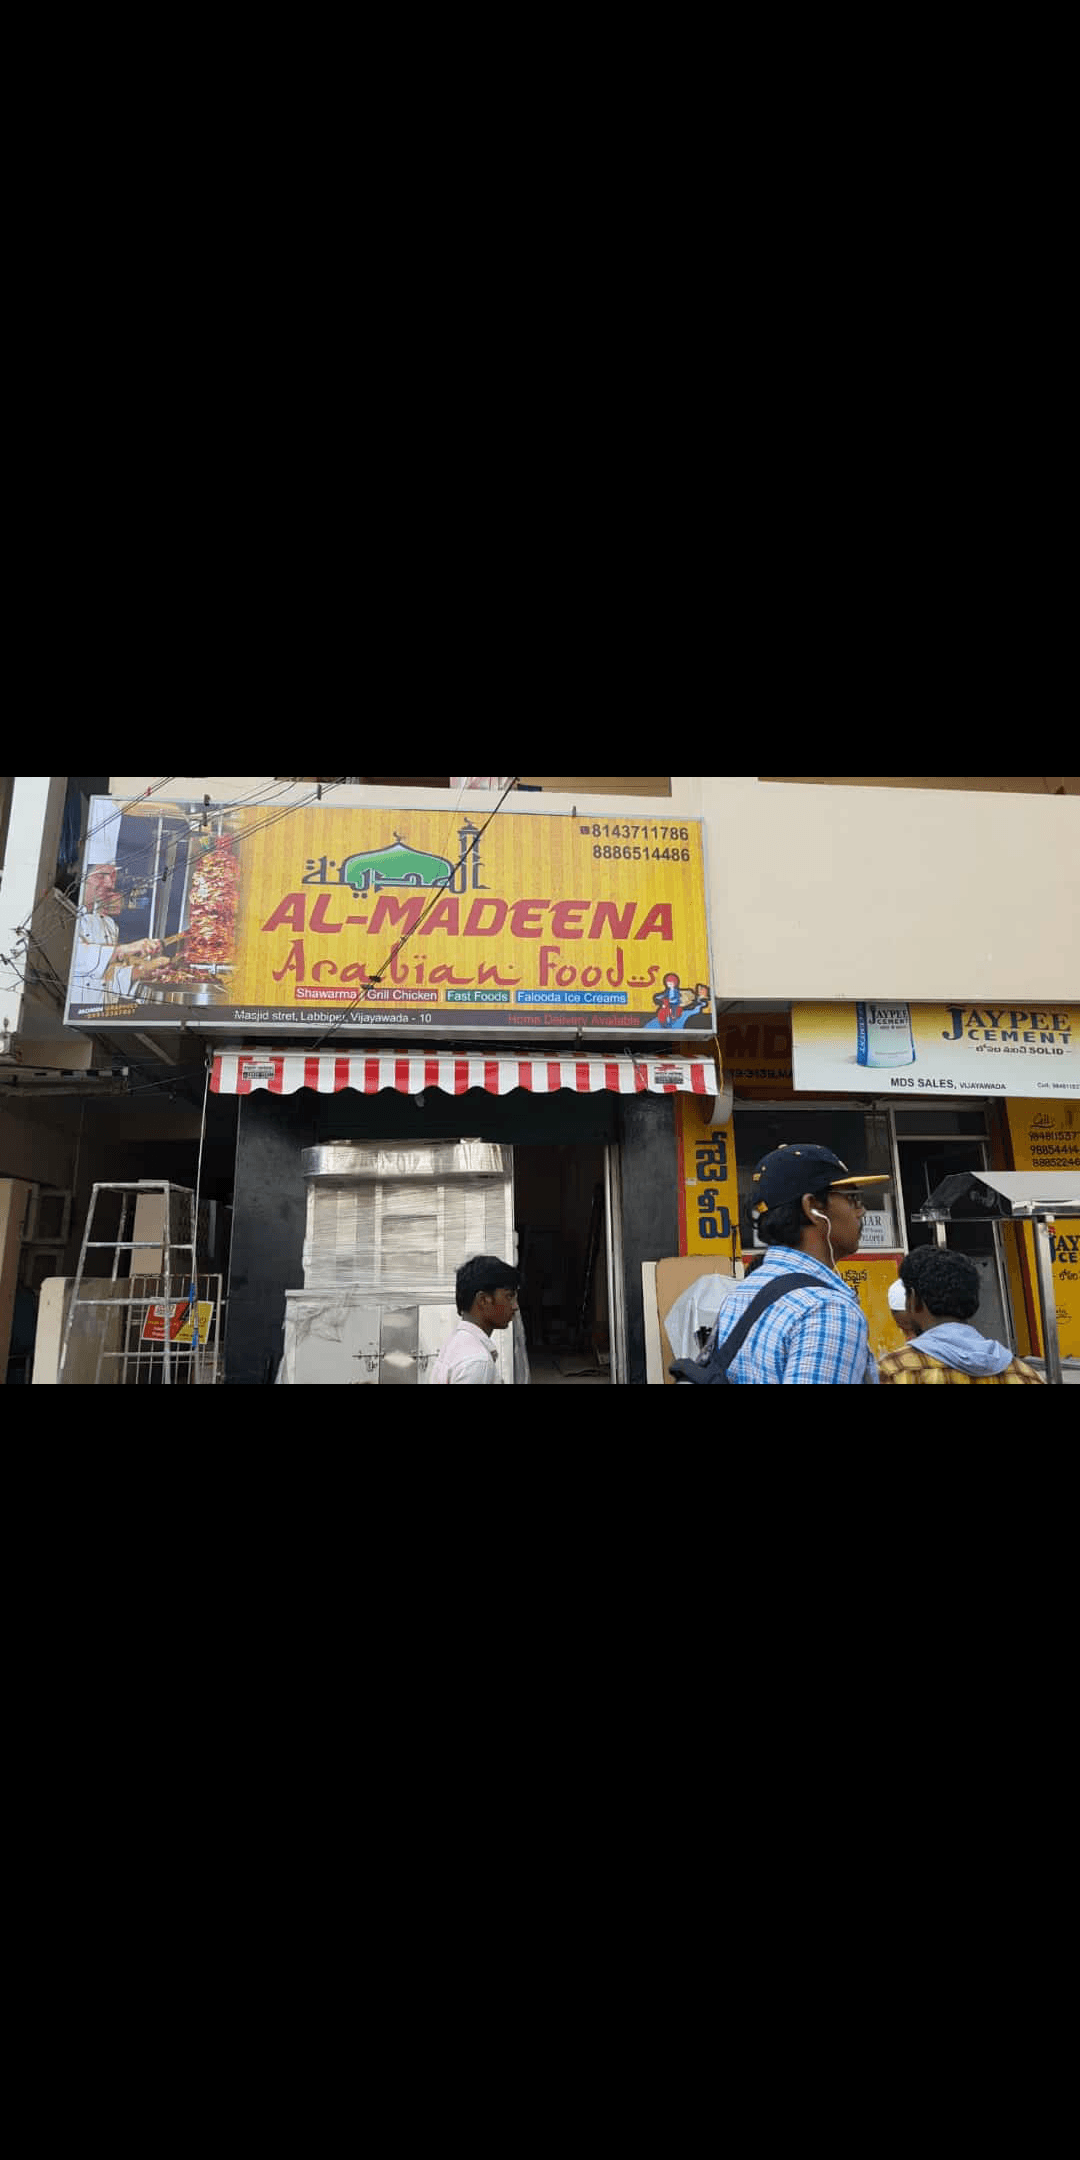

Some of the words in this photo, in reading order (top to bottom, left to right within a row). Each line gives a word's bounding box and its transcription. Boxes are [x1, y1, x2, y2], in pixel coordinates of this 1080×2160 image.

[592, 824, 689, 841] 8143711786
[593, 844, 690, 861] 8886514486
[261, 892, 673, 941] AL-MADEENA
[272, 939, 521, 985] Arabian
[538, 945, 660, 988] Foods
[296, 988, 358, 1000] Shawarma
[366, 988, 390, 1001] Grill
[392, 988, 438, 1001] Chicken
[447, 990, 471, 1002] Fast
[474, 991, 508, 1002] Foods
[517, 991, 561, 1003] Falooda
[564, 992, 580, 1003] Ice
[582, 993, 626, 1004] Creams
[234, 1010, 269, 1021] Masjid
[272, 1010, 298, 1022] stret,
[350, 1013, 408, 1024] Vijayawada
[420, 1014, 432, 1023] 10
[508, 1015, 542, 1025] Home
[942, 1003, 1072, 1041] JAYPEE
[968, 1029, 1072, 1044] CEMENT
[1029, 1046, 1064, 1056] SOLID
[890, 1077, 914, 1088] MDS
[917, 1078, 957, 1090] SALES,
[959, 1082, 1007, 1090] VIJAYAWADA
